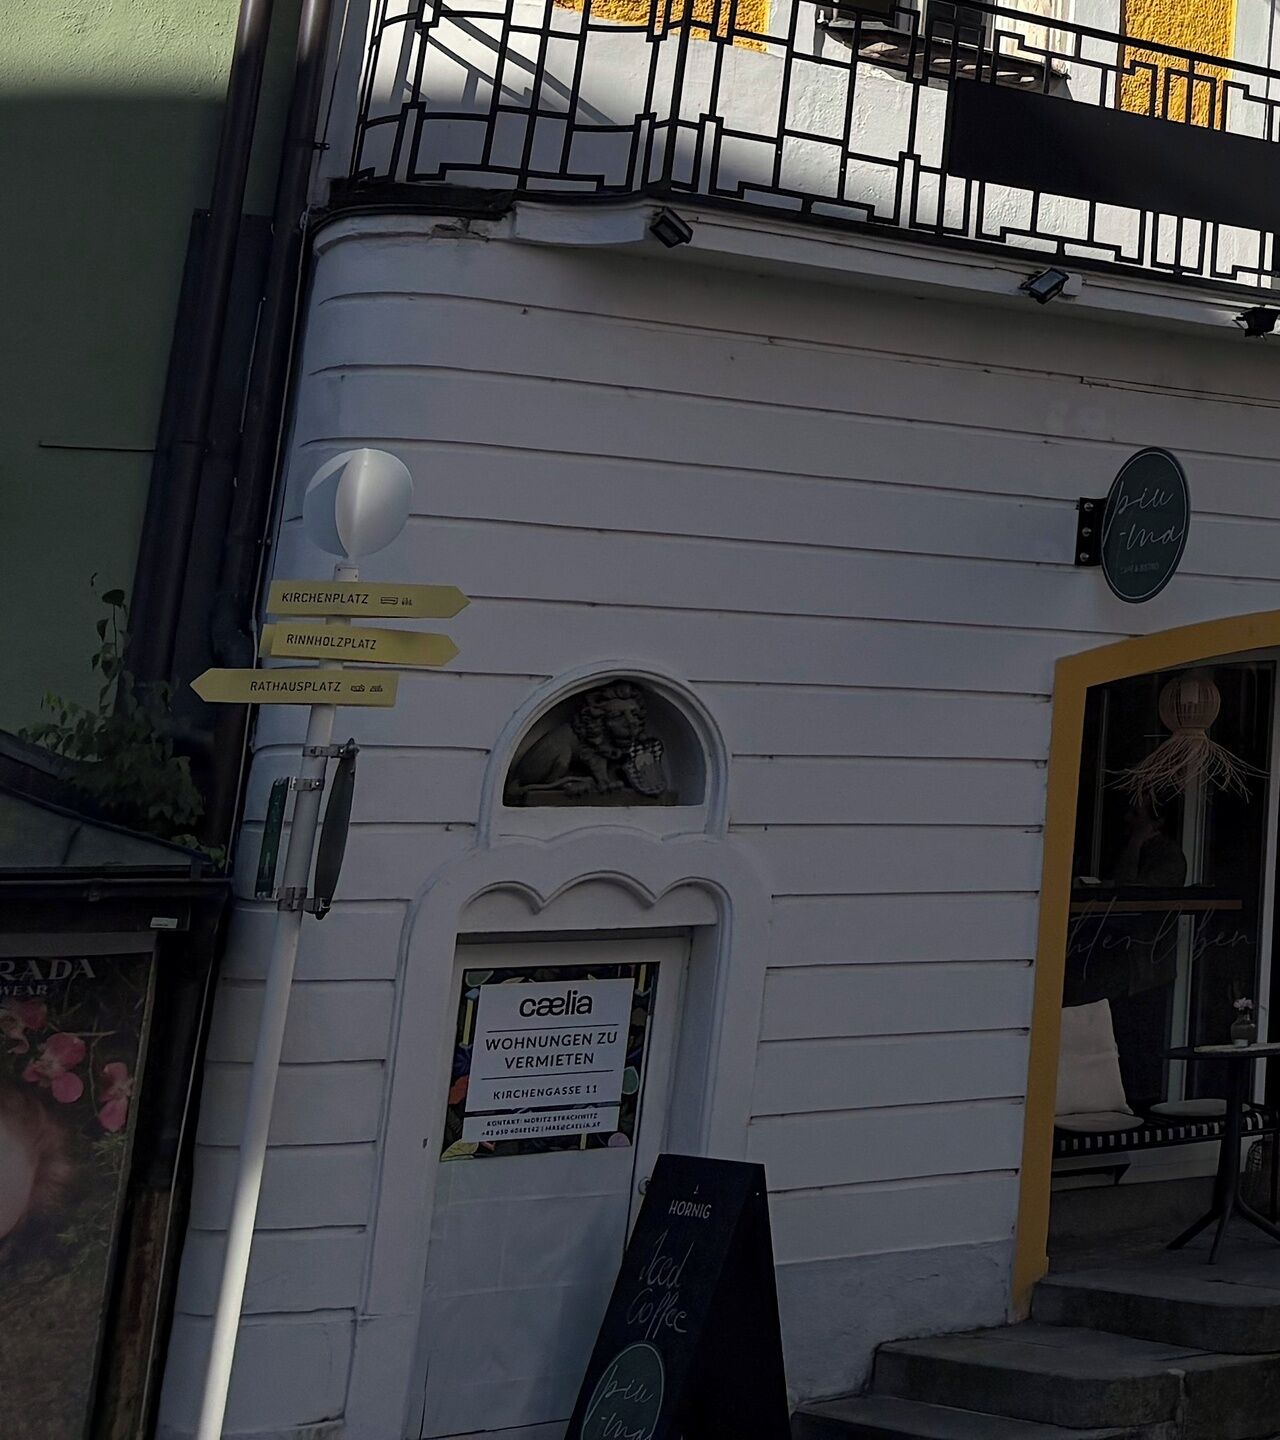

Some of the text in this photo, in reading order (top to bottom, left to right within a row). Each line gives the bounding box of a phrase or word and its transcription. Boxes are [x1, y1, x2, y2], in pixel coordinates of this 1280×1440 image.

[281, 592, 369, 604] KIRCHENPLATZ
[286, 634, 377, 650] RINNHOLZPLATZ
[249, 681, 341, 692] RATHAUSPLATZ
[0, 959, 96, 981] RADA
[0, 984, 48, 996] WEAR
[485, 1031, 618, 1051] WOHNUNGEN ZU
[505, 1053, 594, 1069] VERMIETEN
[493, 1085, 598, 1100] KIRCHENGASSE 11
[668, 1199, 712, 1219] HORNIG
